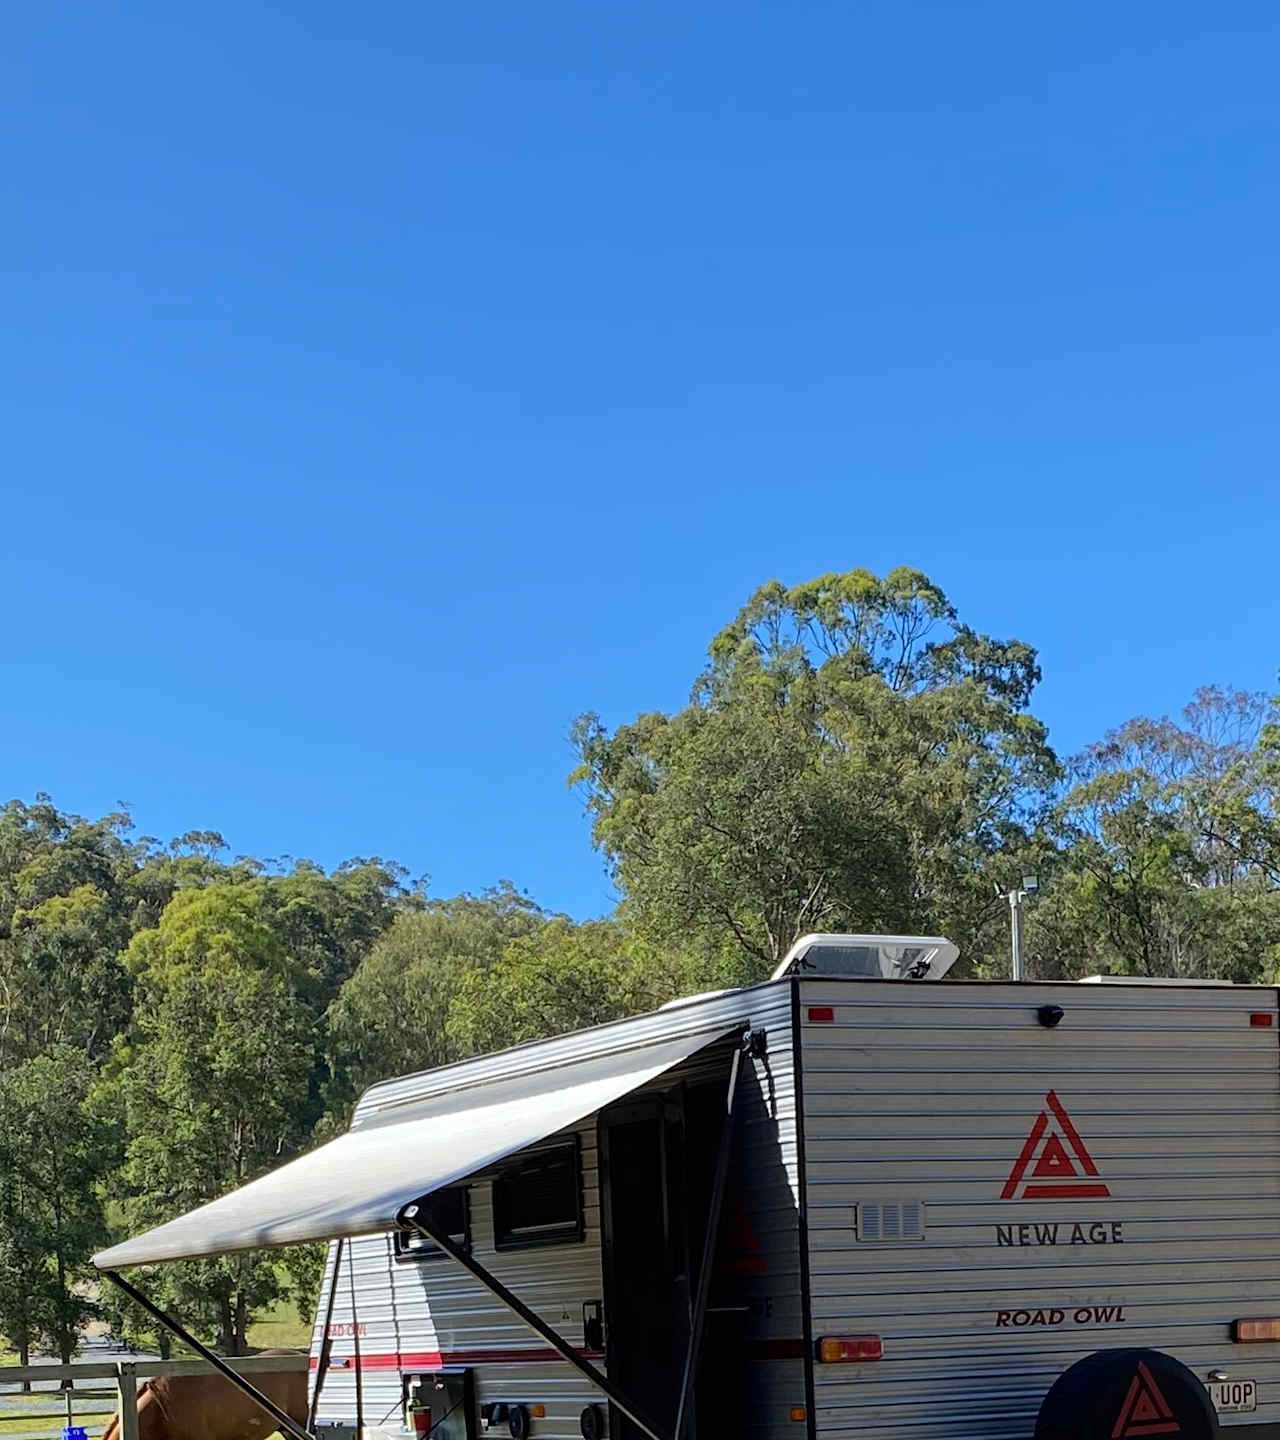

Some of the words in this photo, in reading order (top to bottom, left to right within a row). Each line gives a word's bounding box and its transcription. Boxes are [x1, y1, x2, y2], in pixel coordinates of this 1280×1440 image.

[995, 1223, 1058, 1247] NEW
[1070, 1222, 1124, 1245] AGE
[996, 1308, 1065, 1327] ROAD
[1073, 1306, 1126, 1324] OWL
